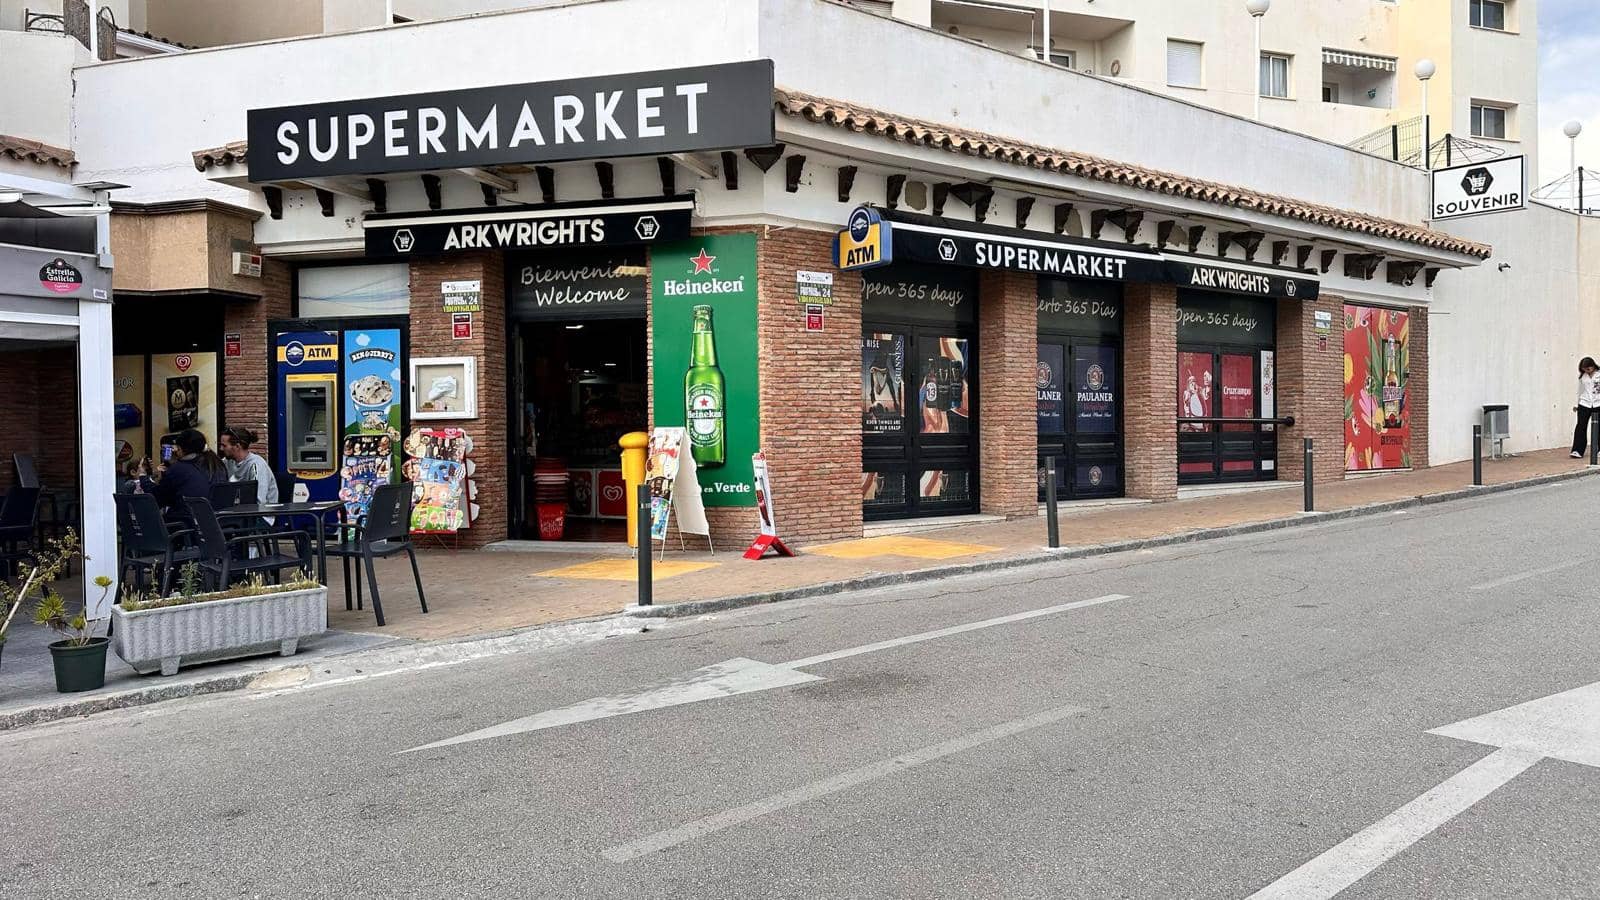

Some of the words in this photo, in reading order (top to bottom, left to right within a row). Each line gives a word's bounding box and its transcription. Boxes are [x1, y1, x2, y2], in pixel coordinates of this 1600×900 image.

[276, 82, 709, 165] SUPERMARKET
[1436, 192, 1519, 216] SOUVENIR
[443, 218, 605, 250] ARKWRIGHTS
[846, 244, 875, 266] ATM
[975, 241, 1127, 279] SUPERMARKET
[46, 266, 75, 276] Estrella
[47, 273, 74, 282] Galicia
[1190, 268, 1270, 295] ARKWRIGHTS
[535, 285, 630, 307] Welcome
[663, 278, 744, 296] Heineken
[898, 282, 927, 299] 365
[931, 283, 963, 307] days
[468, 295, 478, 305] 24
[1036, 297, 1063, 313] erto
[1064, 300, 1088, 315] 365
[1092, 301, 1117, 319] Días
[1176, 308, 1205, 326] Open
[1207, 312, 1230, 326] 365
[1232, 313, 1258, 332] days
[307, 347, 332, 358] ATM
[866, 339, 880, 349] RISE
[894, 340, 902, 385] GUINNESS
[927, 388, 936, 397] 13
[1077, 392, 1113, 402] PAULANER
[687, 408, 723, 419] Heineken
[714, 482, 751, 493] Verde
